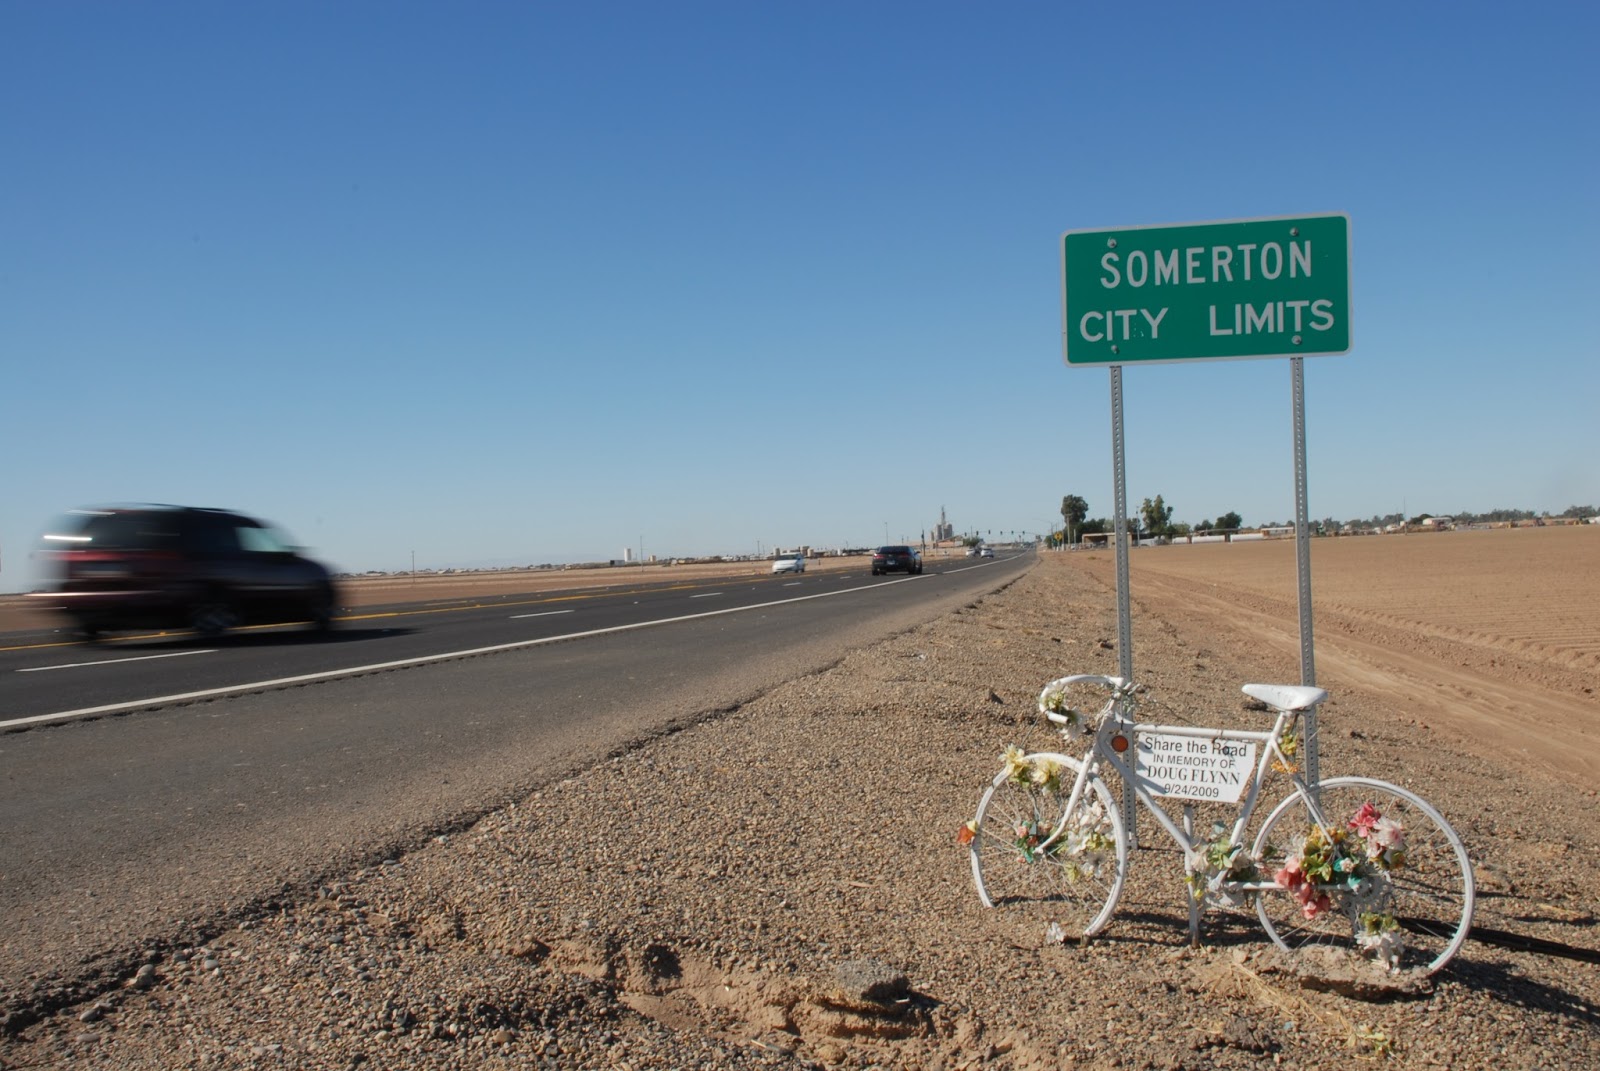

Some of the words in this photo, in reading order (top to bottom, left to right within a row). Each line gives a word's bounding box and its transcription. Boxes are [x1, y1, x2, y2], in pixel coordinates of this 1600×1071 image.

[1100, 240, 1312, 289] SOMERTON
[1079, 307, 1169, 343] CITY
[1209, 299, 1335, 336] LIMITS
[1144, 736, 1182, 752] Share
[1187, 741, 1207, 754] the
[1212, 742, 1247, 757] Road
[1153, 754, 1163, 763] IN
[1167, 755, 1216, 767] MEMORY
[1220, 760, 1235, 769] OF
[1147, 765, 1187, 781] DOUG
[1191, 770, 1240, 785] FLYNN
[1164, 783, 1219, 798] 9/24/2009
